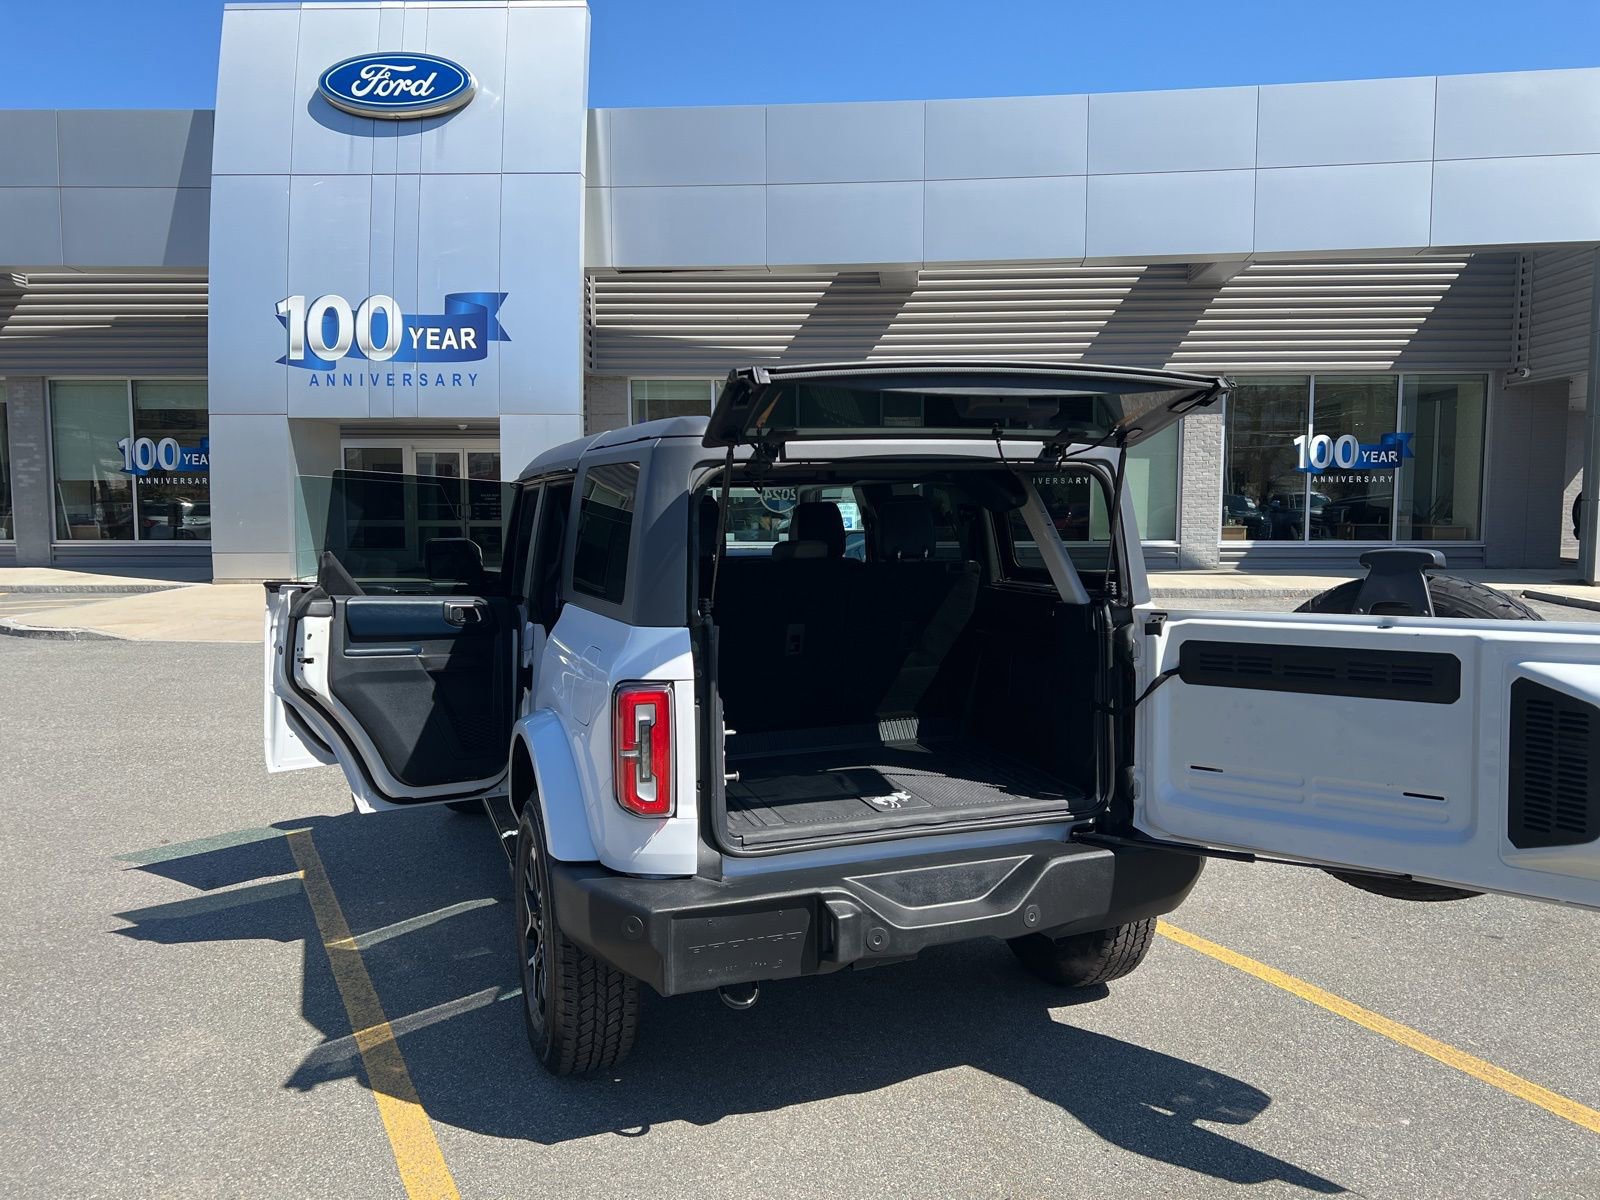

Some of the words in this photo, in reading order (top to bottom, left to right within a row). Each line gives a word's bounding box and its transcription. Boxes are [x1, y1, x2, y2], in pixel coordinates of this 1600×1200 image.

[351, 64, 437, 96] Ford
[275, 294, 403, 361] 100
[408, 327, 477, 350] YEAR
[309, 373, 478, 387] ANNIVERSARY
[118, 437, 180, 471] 100
[183, 453, 210, 465] YEA
[1293, 434, 1360, 469] 100
[1361, 450, 1398, 463] YEAR
[138, 477, 208, 485] ANNIVERSAR
[1032, 477, 1089, 485] IVERSARY
[1312, 475, 1393, 483] ANNIVERSARY
